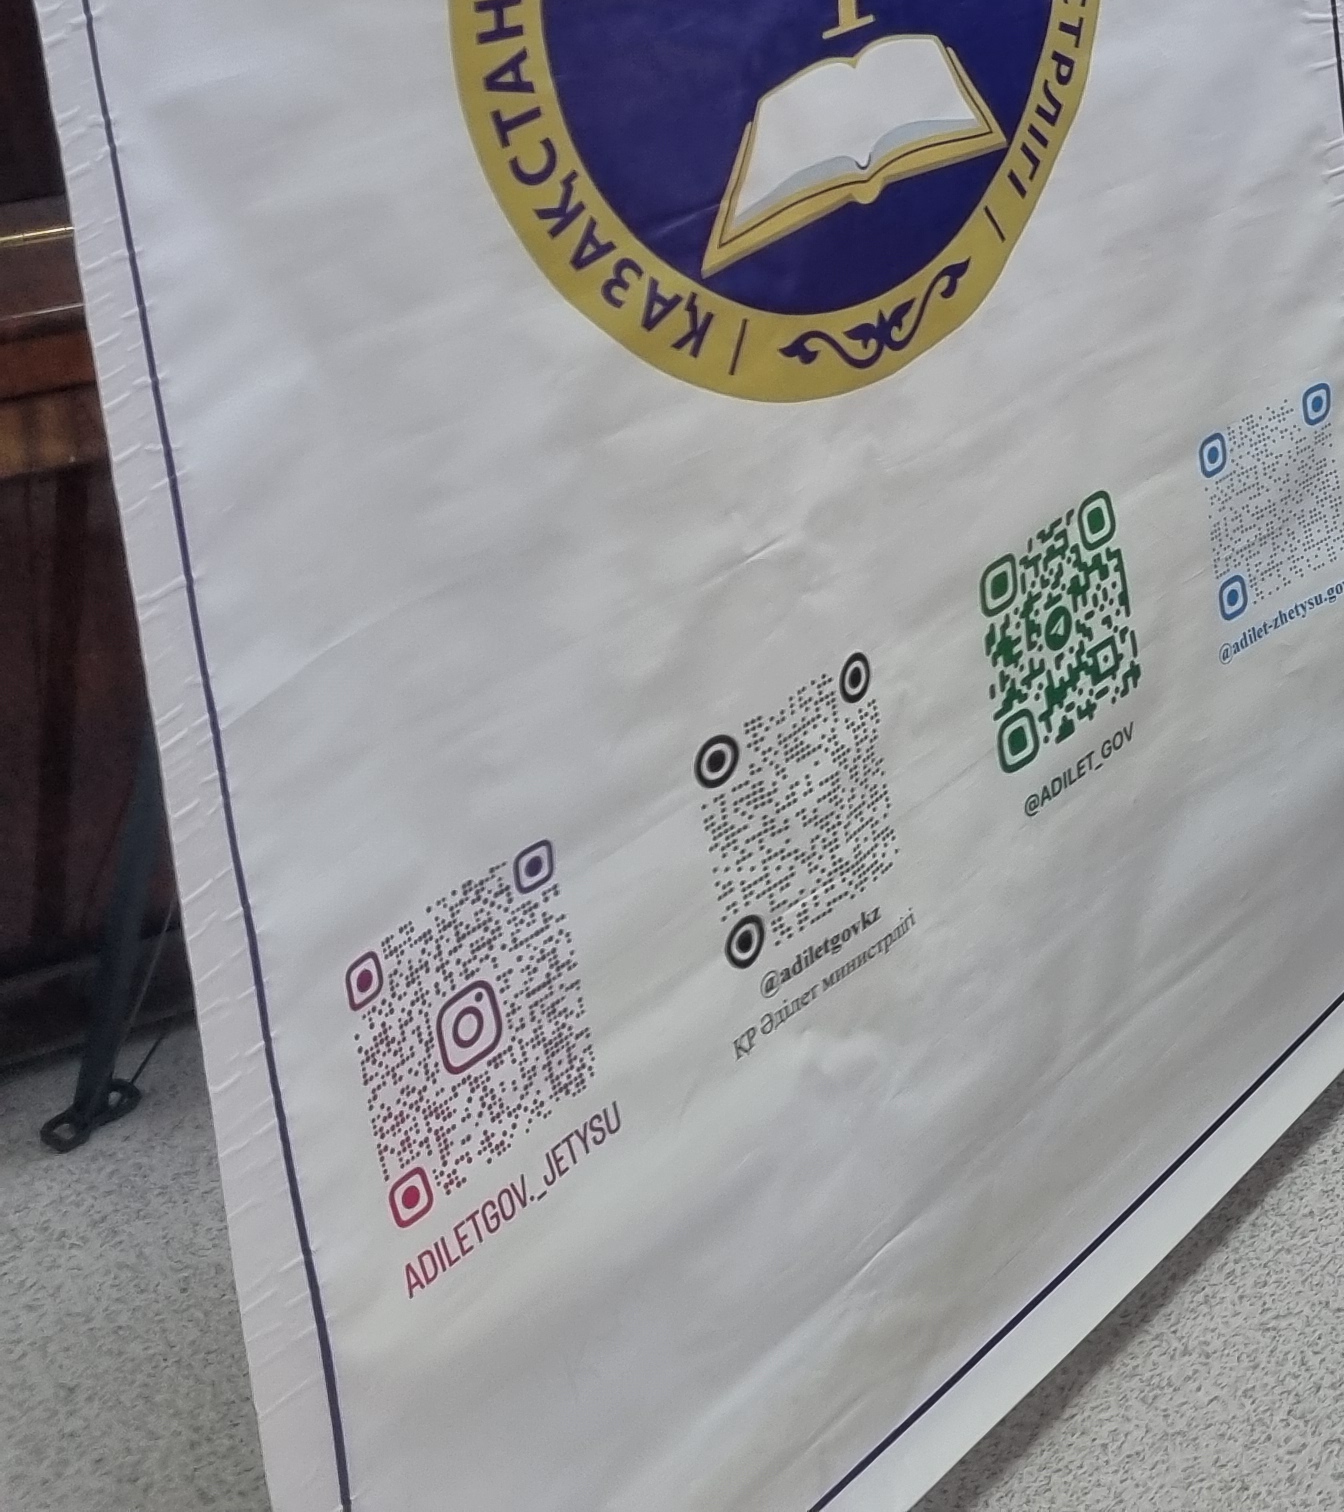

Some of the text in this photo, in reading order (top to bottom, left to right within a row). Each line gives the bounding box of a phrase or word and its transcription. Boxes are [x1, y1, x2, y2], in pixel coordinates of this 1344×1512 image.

[1024, 721, 1135, 817] @ADILET_GOV
[760, 983, 820, 1035] Әділет
[821, 907, 916, 993] министрлігі
